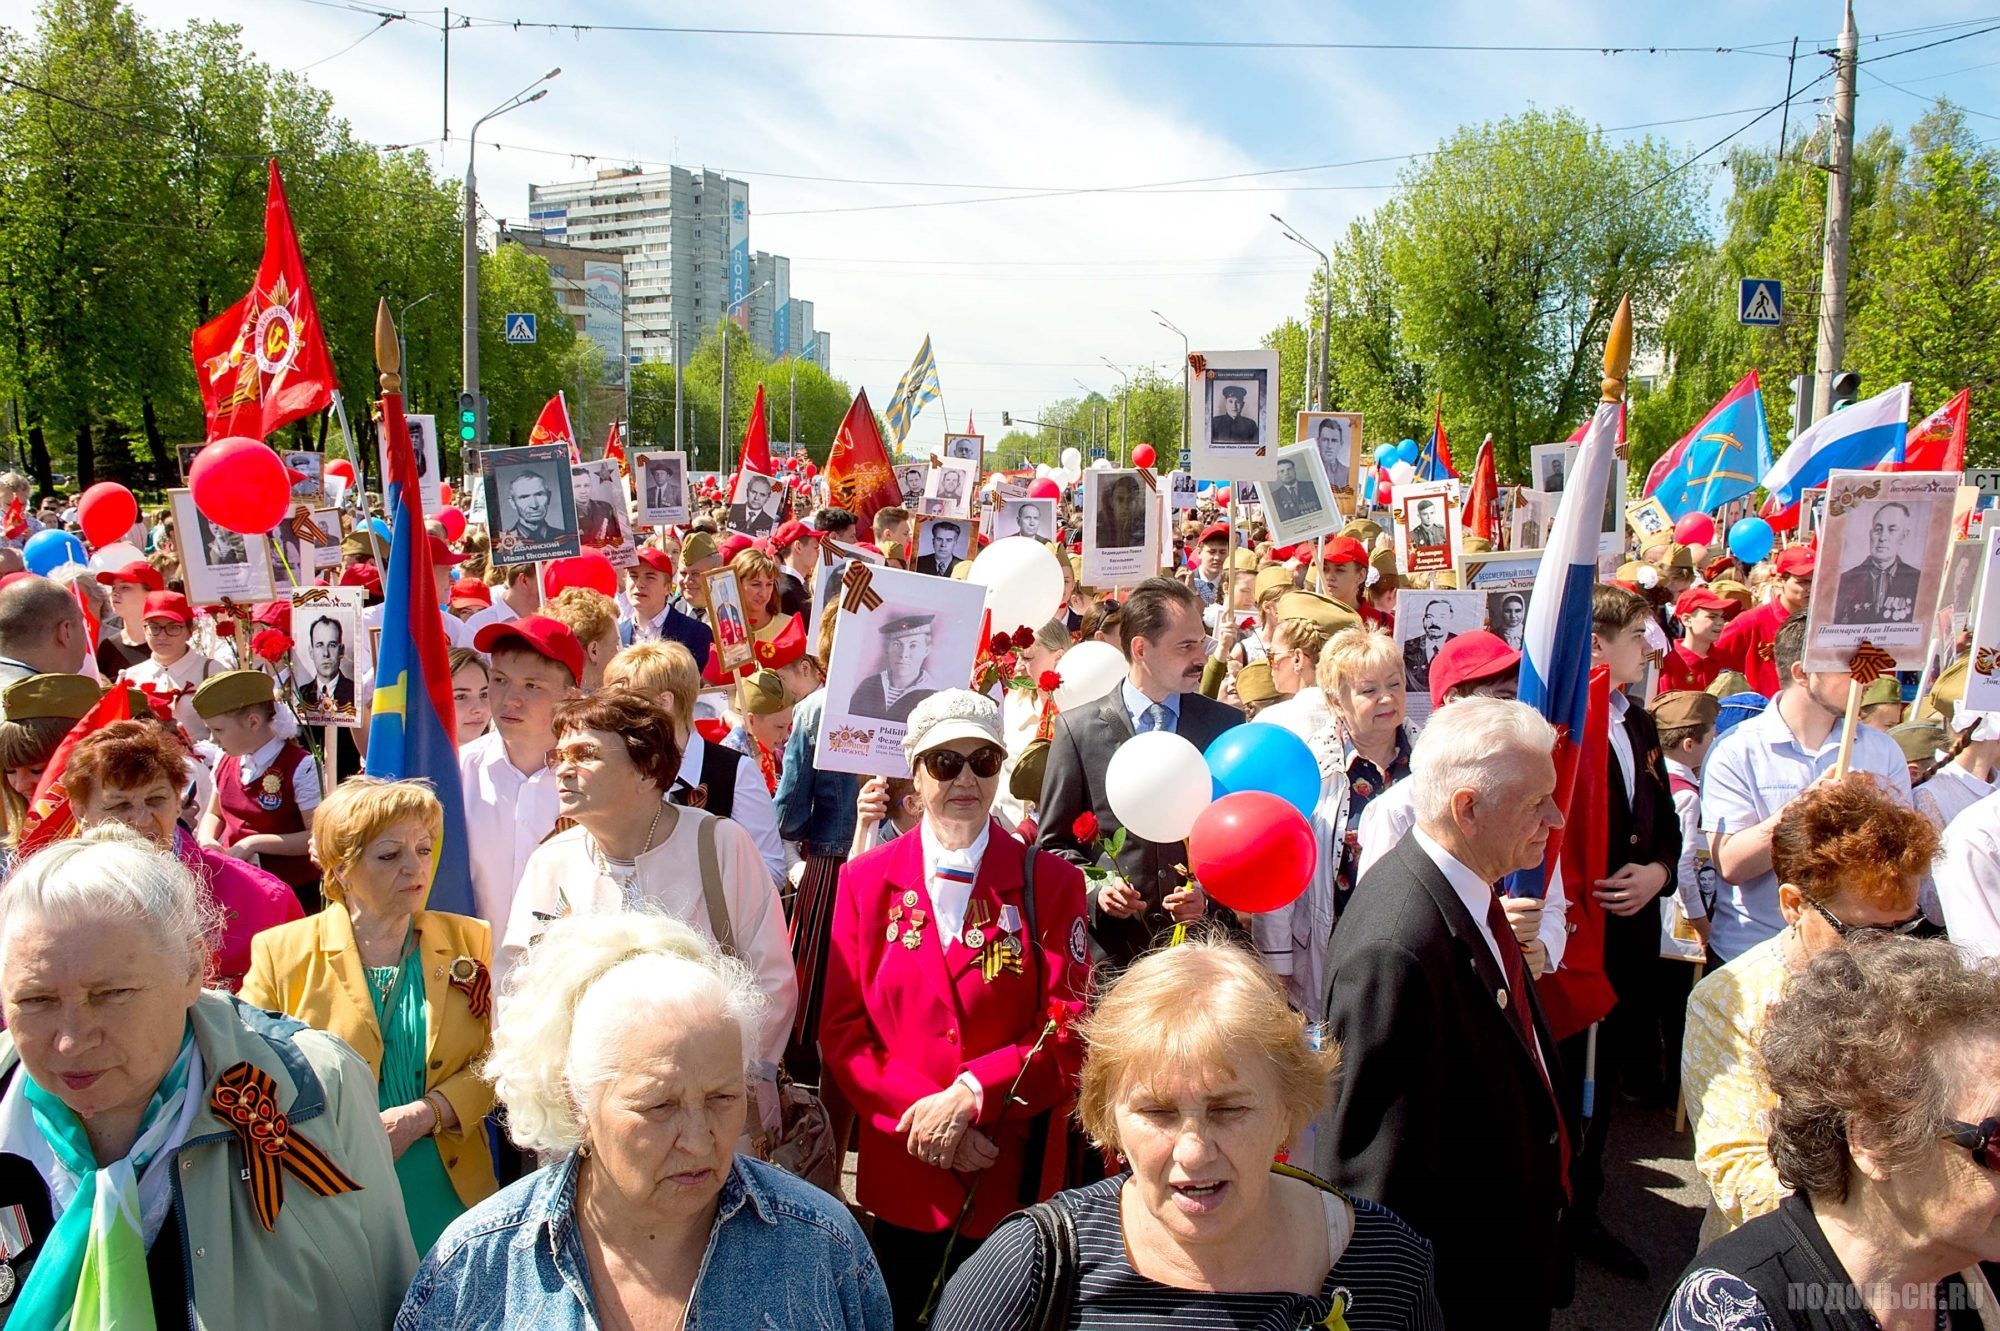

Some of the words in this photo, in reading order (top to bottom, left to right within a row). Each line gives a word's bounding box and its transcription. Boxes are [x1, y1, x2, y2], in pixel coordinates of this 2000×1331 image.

[503, 553, 525, 563] Иван
[1479, 569, 1517, 580] БЕССМЕРТНЫЙ
[1883, 625, 1920, 633] Иванович
[879, 726, 908, 736] РЫБИ
